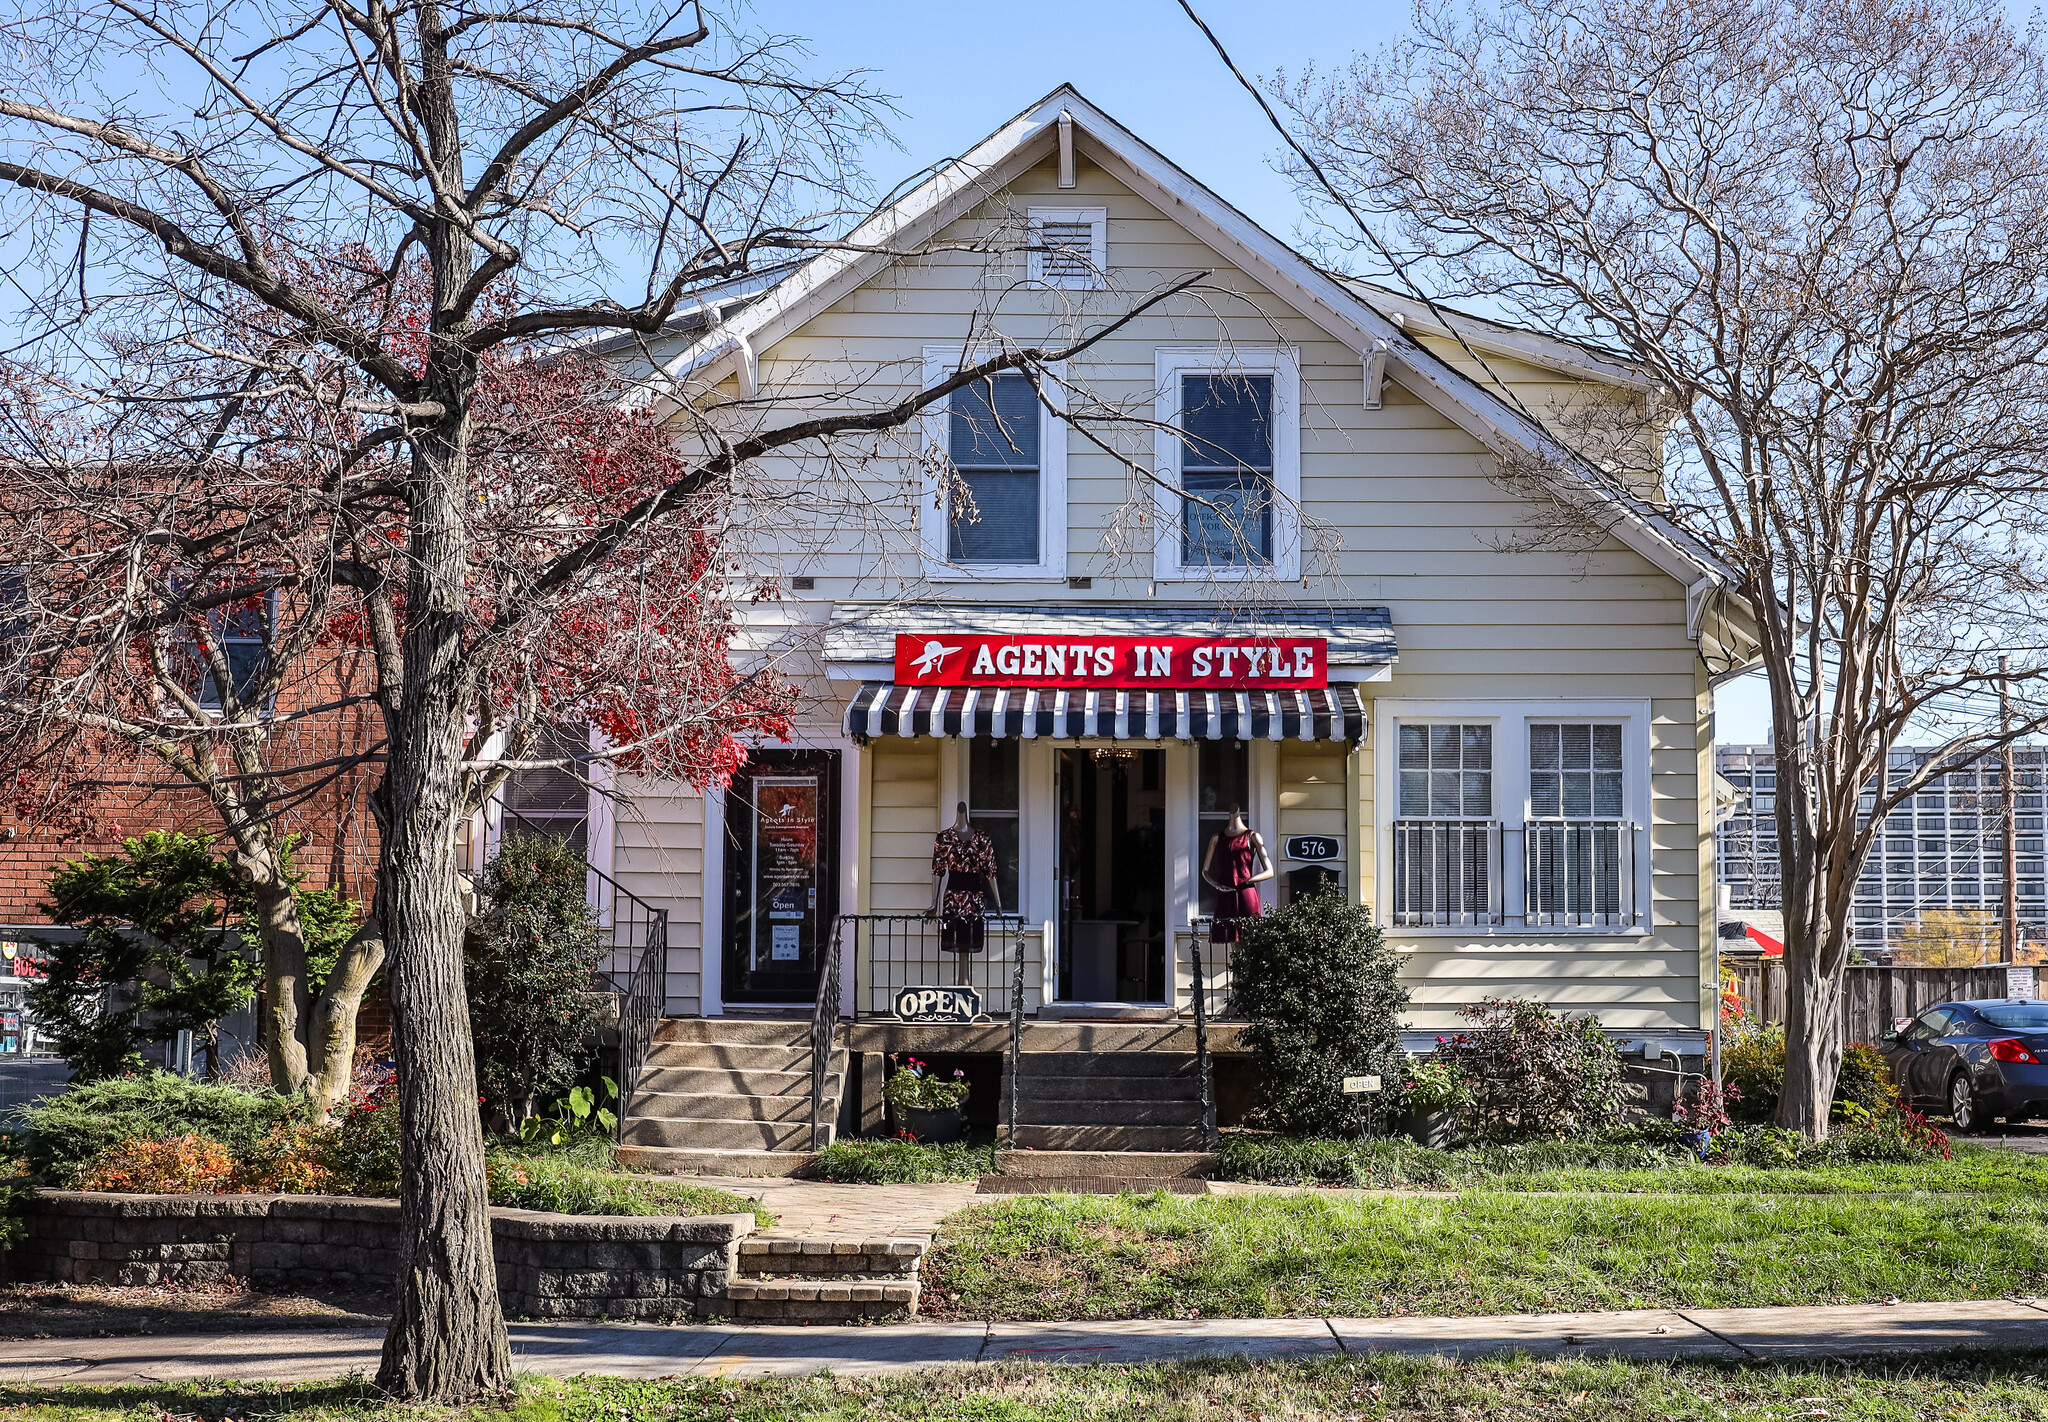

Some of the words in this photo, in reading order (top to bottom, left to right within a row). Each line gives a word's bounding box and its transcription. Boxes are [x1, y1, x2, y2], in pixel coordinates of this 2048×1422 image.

[971, 644, 1115, 678] AGENTS
[1134, 646, 1172, 678] IN
[1192, 646, 1314, 678] STYLE
[1301, 841, 1326, 855] 576
[773, 901, 795, 910] Open
[900, 990, 974, 1018] OPEN
[1350, 1079, 1375, 1089] OPEN
